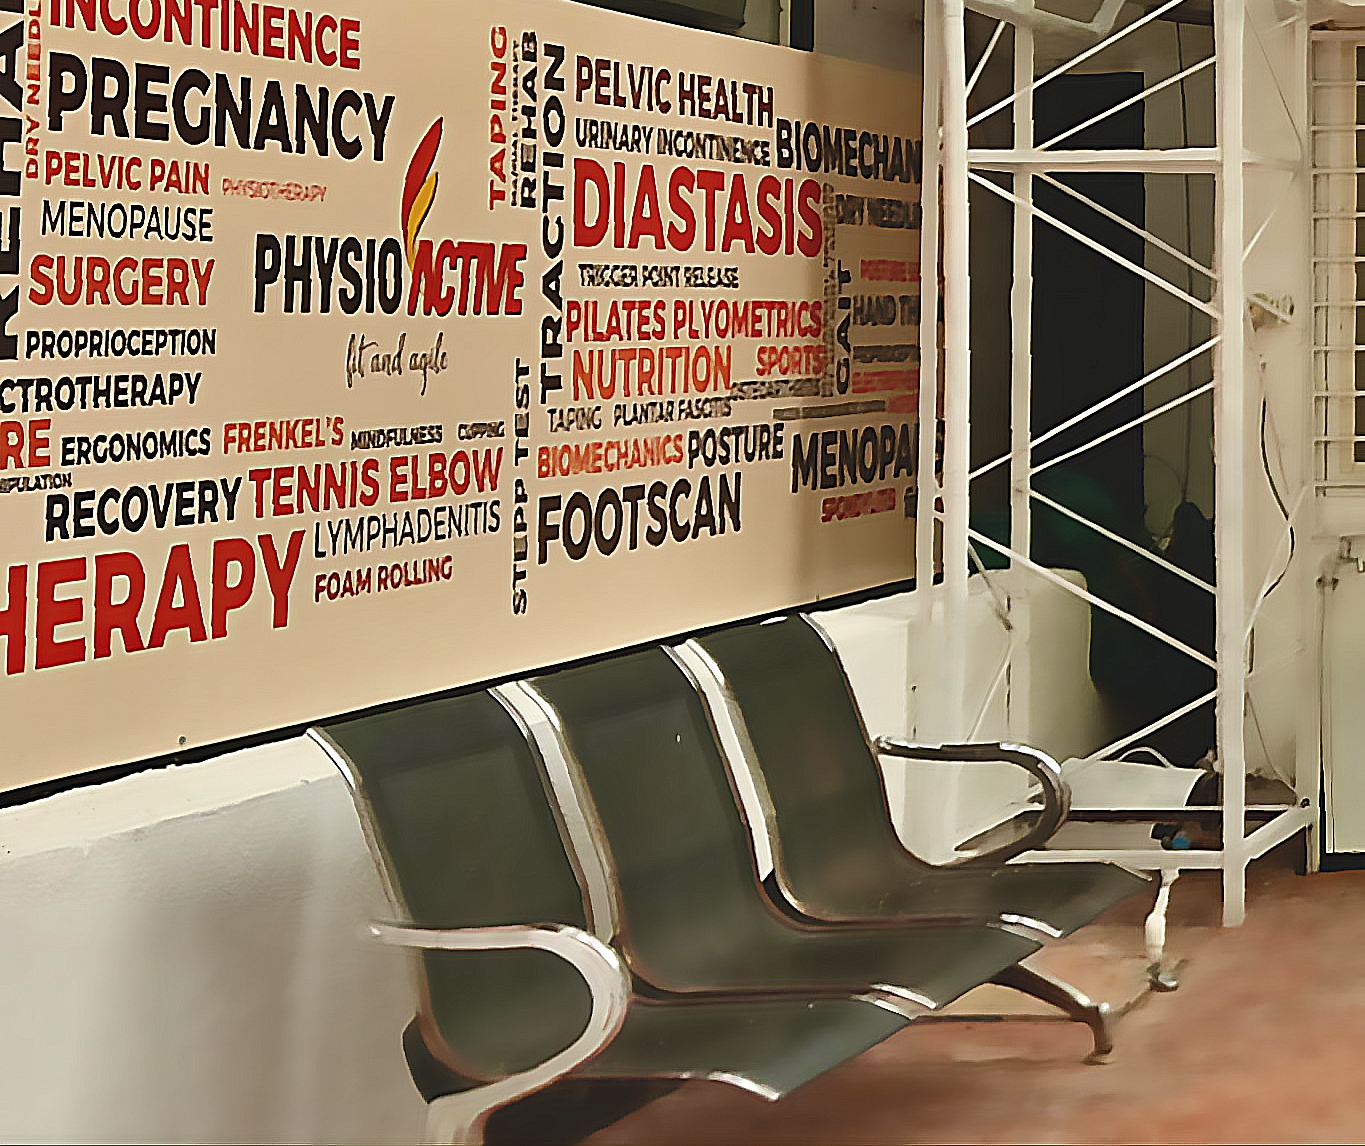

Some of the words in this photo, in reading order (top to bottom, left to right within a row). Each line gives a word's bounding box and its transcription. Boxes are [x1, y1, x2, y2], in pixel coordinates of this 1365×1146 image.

[47, 51, 396, 162] PREGNANCY
[489, 26, 507, 210] TAPING
[520, 31, 537, 208] REHAB
[576, 55, 671, 114] PELVIC
[679, 72, 773, 128] HEALTH
[26, 115, 41, 179] DRY
[576, 118, 653, 155] URINARY
[45, 150, 142, 192] PELVIC
[150, 159, 210, 196] PAIN
[41, 199, 214, 242] MENOPAUSE
[540, 43, 565, 404] TRACTION
[573, 157, 823, 258] DIASTASIS
[28, 253, 216, 307] SURGERY
[254, 234, 402, 314] PHYSIO
[407, 239, 527, 316] ACTIVE
[25, 329, 216, 359] PROPRIOCEPTION
[566, 300, 666, 342] PILATES
[674, 300, 822, 339] PLYOMETRICS
[371, 333, 407, 376] and
[572, 345, 732, 402] NUTRITION
[756, 345, 827, 377] SPORTS
[60, 428, 211, 467] ERGONOMICS
[223, 416, 345, 455] FRENKEL'S
[514, 358, 529, 467] TEST
[537, 434, 684, 479] BIOMECHANICS
[688, 423, 784, 470] POSTURE
[45, 476, 242, 542] RECOVERY
[249, 459, 380, 519] TENNIS
[390, 447, 503, 503] ELBOW
[537, 471, 742, 565] FOOTSCAN
[314, 500, 501, 558] LYMPHADENITIS
[315, 567, 371, 603] FOAM
[377, 555, 453, 592] ROLLING
